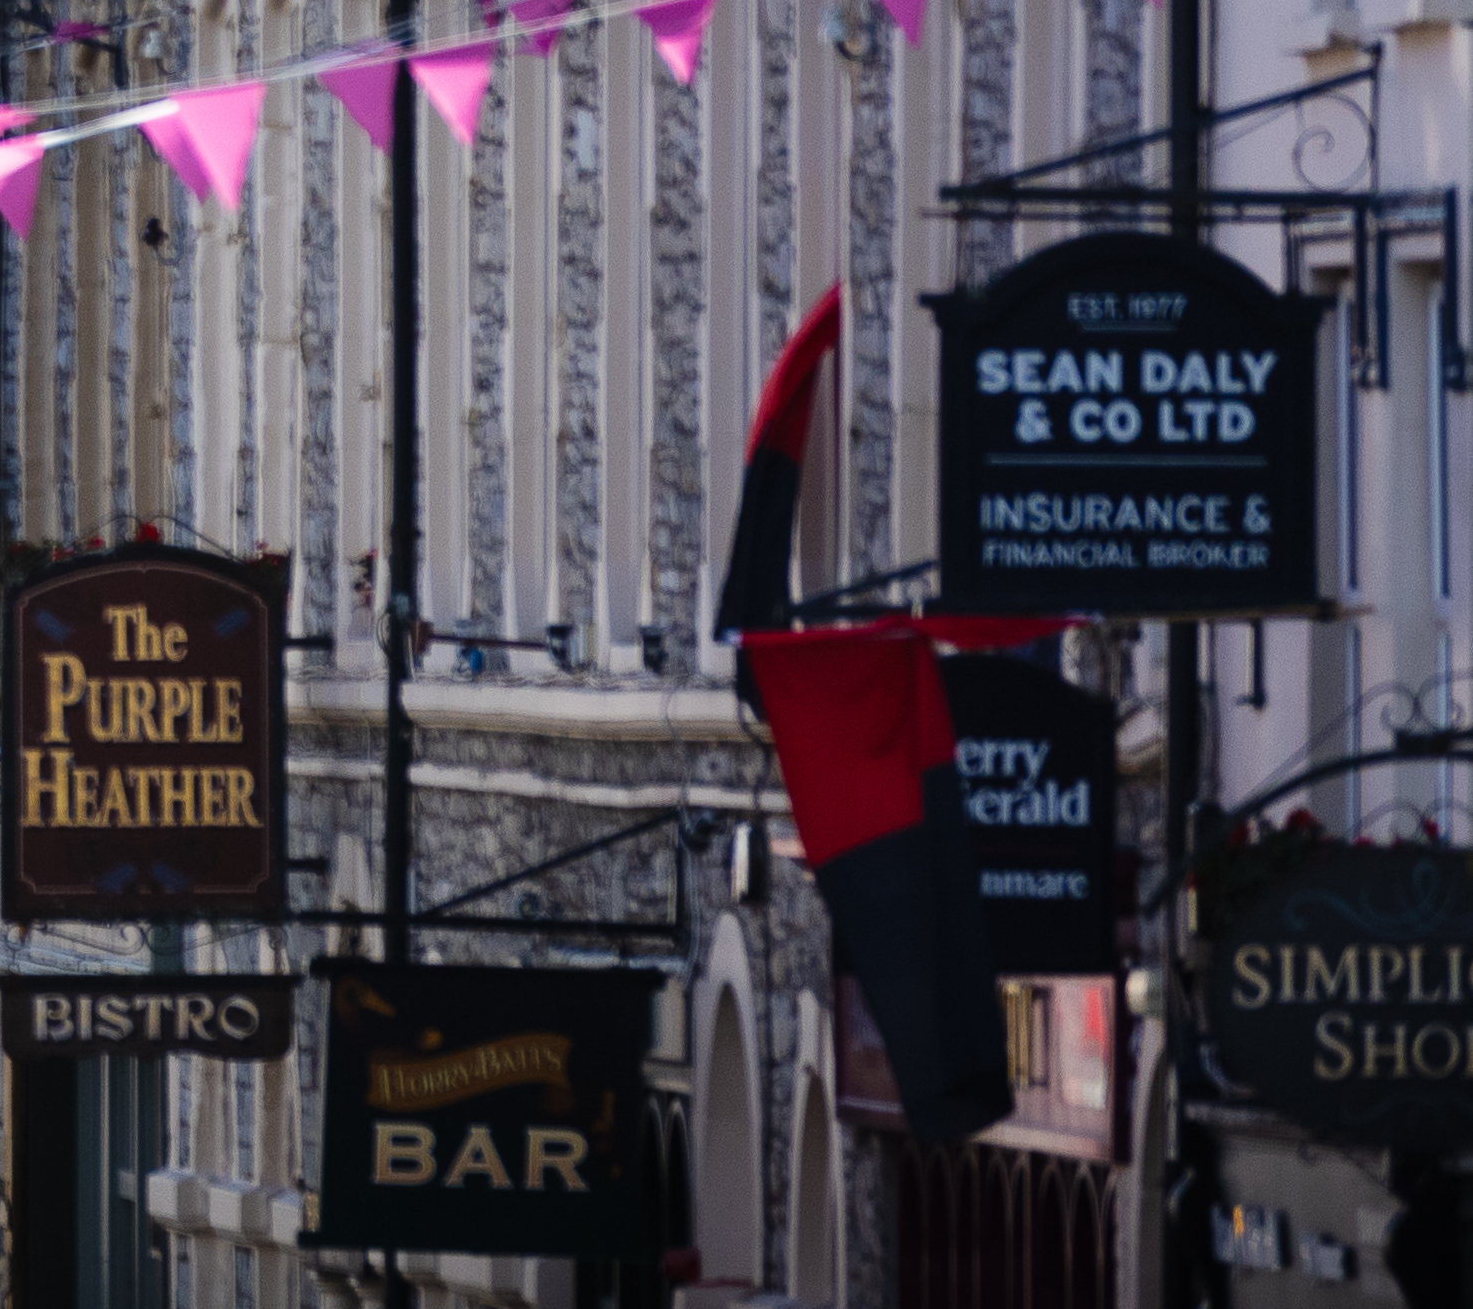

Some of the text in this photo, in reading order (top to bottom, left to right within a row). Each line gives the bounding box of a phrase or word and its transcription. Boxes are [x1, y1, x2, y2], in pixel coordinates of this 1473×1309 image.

[975, 348, 1278, 395] SEAN DALY
[1015, 399, 1256, 443] & CO LTD
[981, 491, 1273, 534] INSURANCE &
[983, 541, 1138, 568] FINANCIAL
[104, 603, 188, 661] The
[42, 652, 243, 743] PURPLE
[954, 737, 1051, 788] erry
[22, 748, 264, 828] HEATHER
[962, 778, 1090, 825] erald
[981, 870, 1089, 900] nmare
[1232, 942, 1473, 1010] SIMPLI
[30, 993, 260, 1041] BISTRO
[1313, 1009, 1473, 1082] SHO
[373, 1121, 590, 1191] BAR
